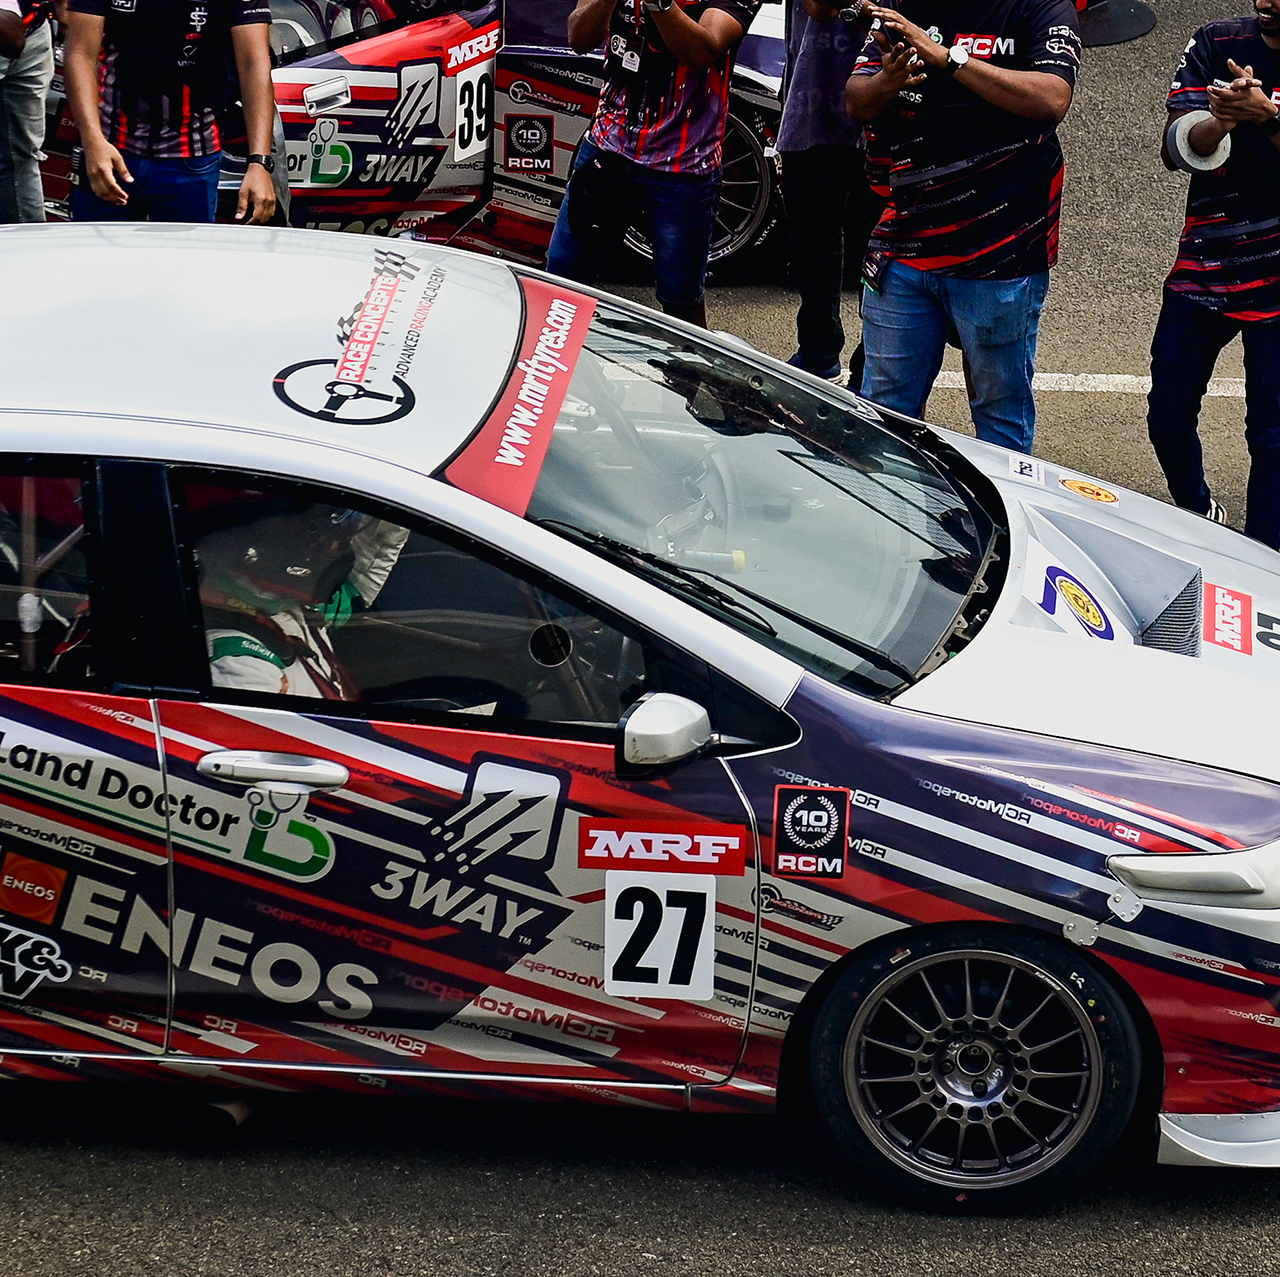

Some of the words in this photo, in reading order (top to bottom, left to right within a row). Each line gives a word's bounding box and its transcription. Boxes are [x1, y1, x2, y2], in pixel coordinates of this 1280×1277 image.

[447, 28, 501, 70] MRF
[458, 71, 493, 151] 39
[518, 129, 541, 140] 10
[359, 154, 434, 183] 3WAY
[507, 157, 551, 169] RCM
[338, 339, 372, 382] RACE
[359, 273, 400, 346] CONCEPTS
[493, 296, 579, 467] www.mrftyres.com
[1214, 586, 1243, 651] MRF
[97, 767, 241, 837] Doctor
[794, 809, 829, 826] 10
[584, 829, 741, 863] MRF
[794, 825, 828, 834] YEARS
[777, 854, 842, 873] RCM
[2, 874, 57, 901] ENEOS
[370, 860, 545, 939] 3WAY
[60, 873, 379, 1021] ENEOS
[610, 884, 709, 987] 27
